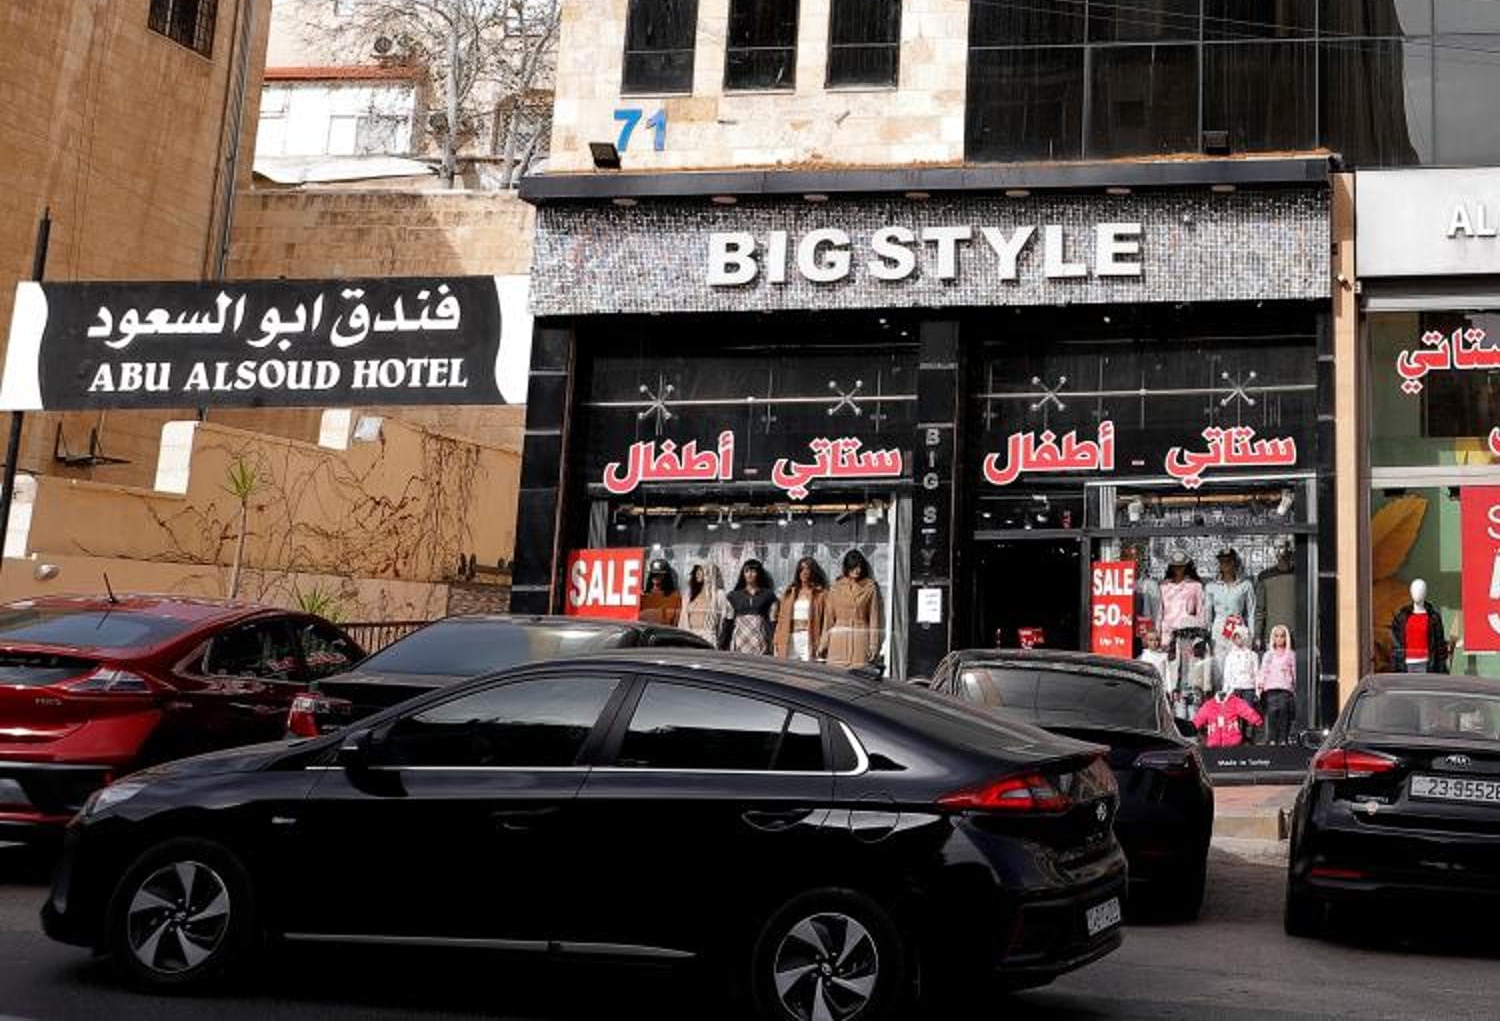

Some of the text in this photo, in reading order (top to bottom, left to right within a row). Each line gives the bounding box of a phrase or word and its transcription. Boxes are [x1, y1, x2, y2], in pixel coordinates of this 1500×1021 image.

[613, 108, 667, 152] 71
[87, 283, 461, 352] فندق ابو السعود
[88, 357, 468, 393] ABU ALSOUD HOTEL
[603, 430, 736, 494] أطفال
[771, 435, 903, 500] ستاتي
[923, 428, 940, 489] BIG
[983, 420, 1116, 486] أطفال
[1165, 424, 1298, 489] ستاتي
[570, 558, 640, 607] SALE
[1092, 568, 1134, 596] SALE
